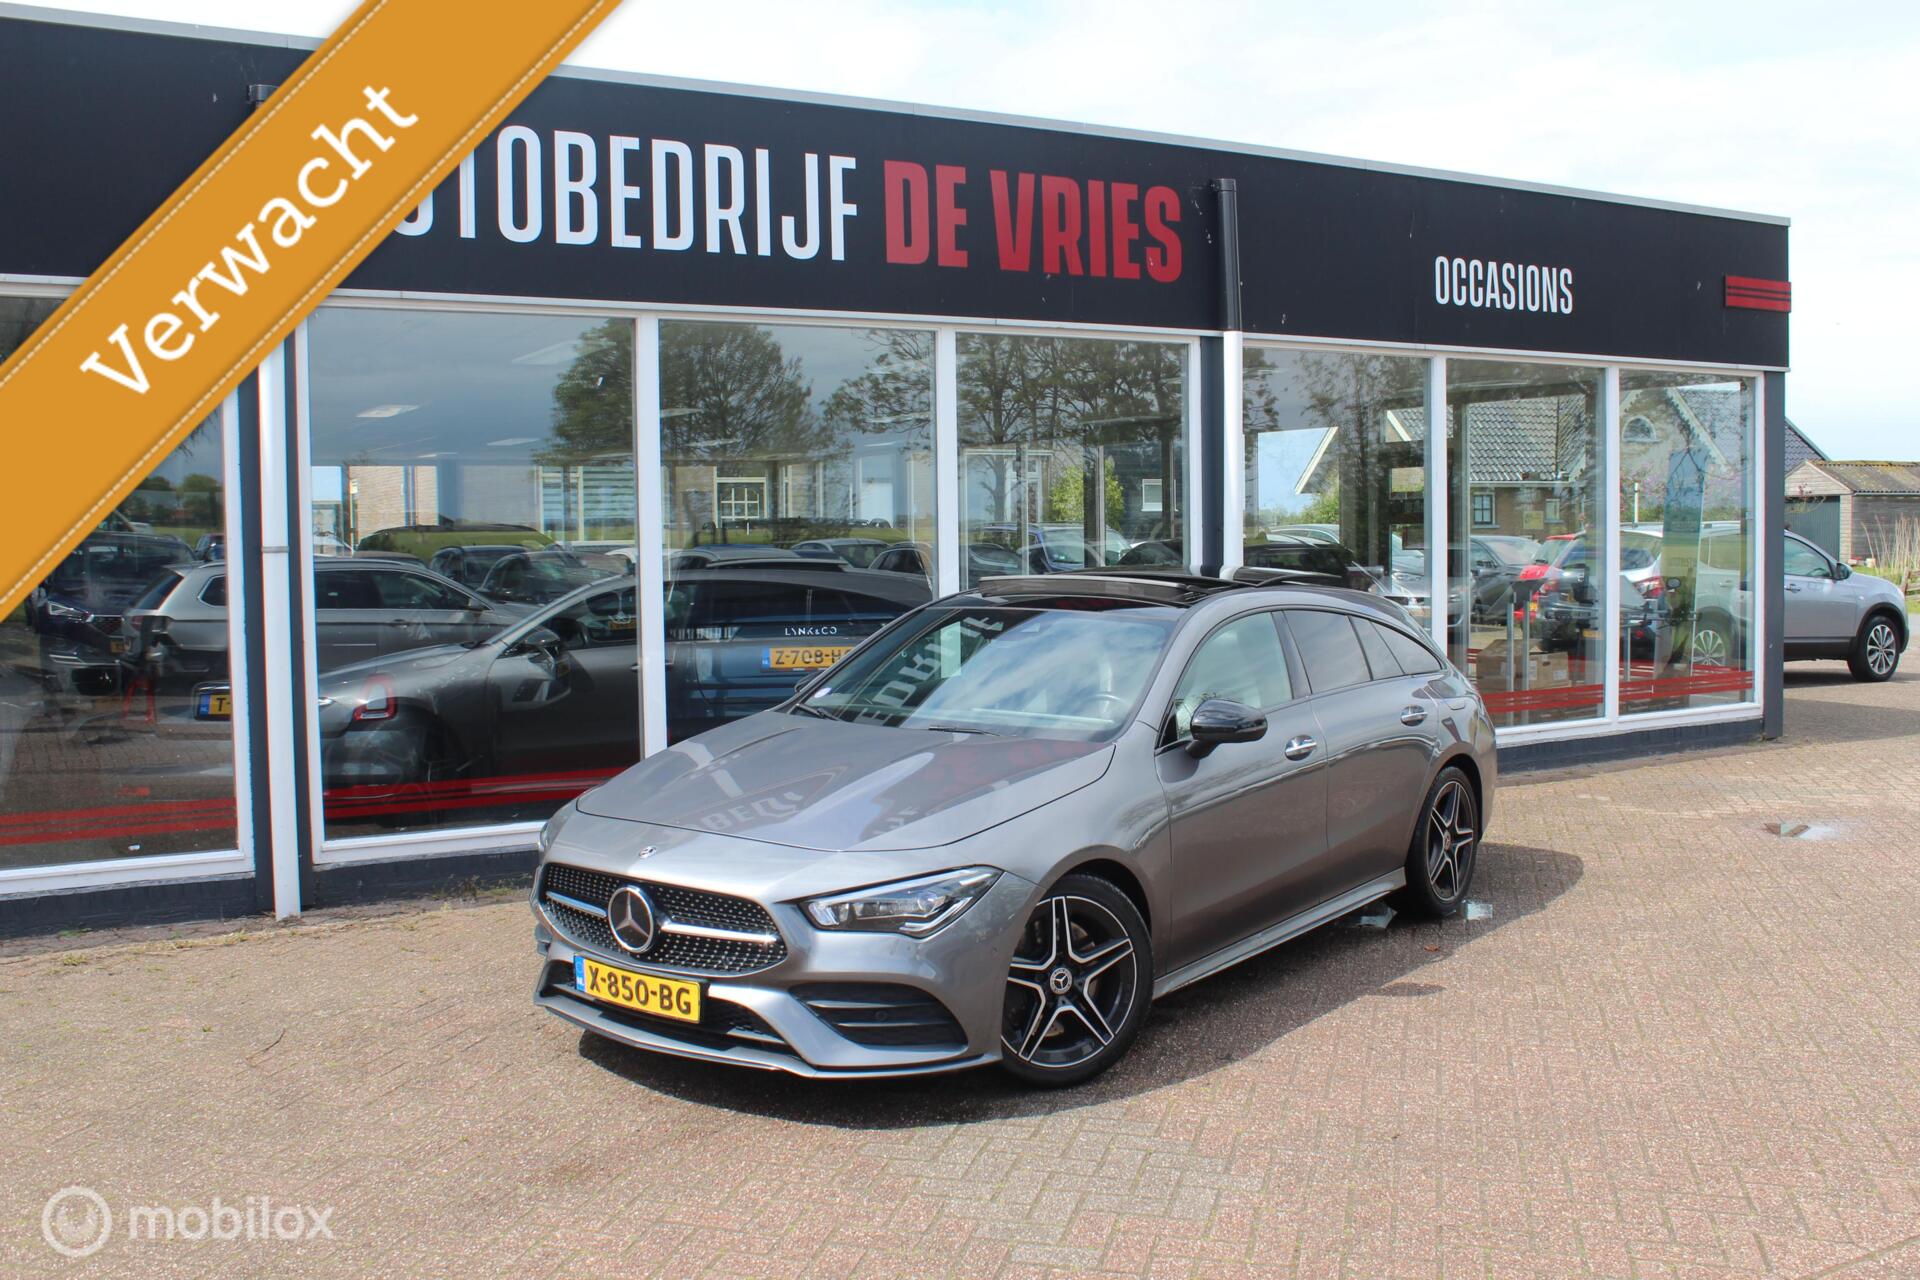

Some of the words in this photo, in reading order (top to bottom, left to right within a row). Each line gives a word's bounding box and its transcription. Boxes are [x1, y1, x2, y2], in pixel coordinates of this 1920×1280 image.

[884, 160, 969, 269] DE
[989, 170, 1183, 283] VRIES
[1434, 255, 1574, 315] OCCASIONS
[588, 964, 692, 1015] X-850-BG
